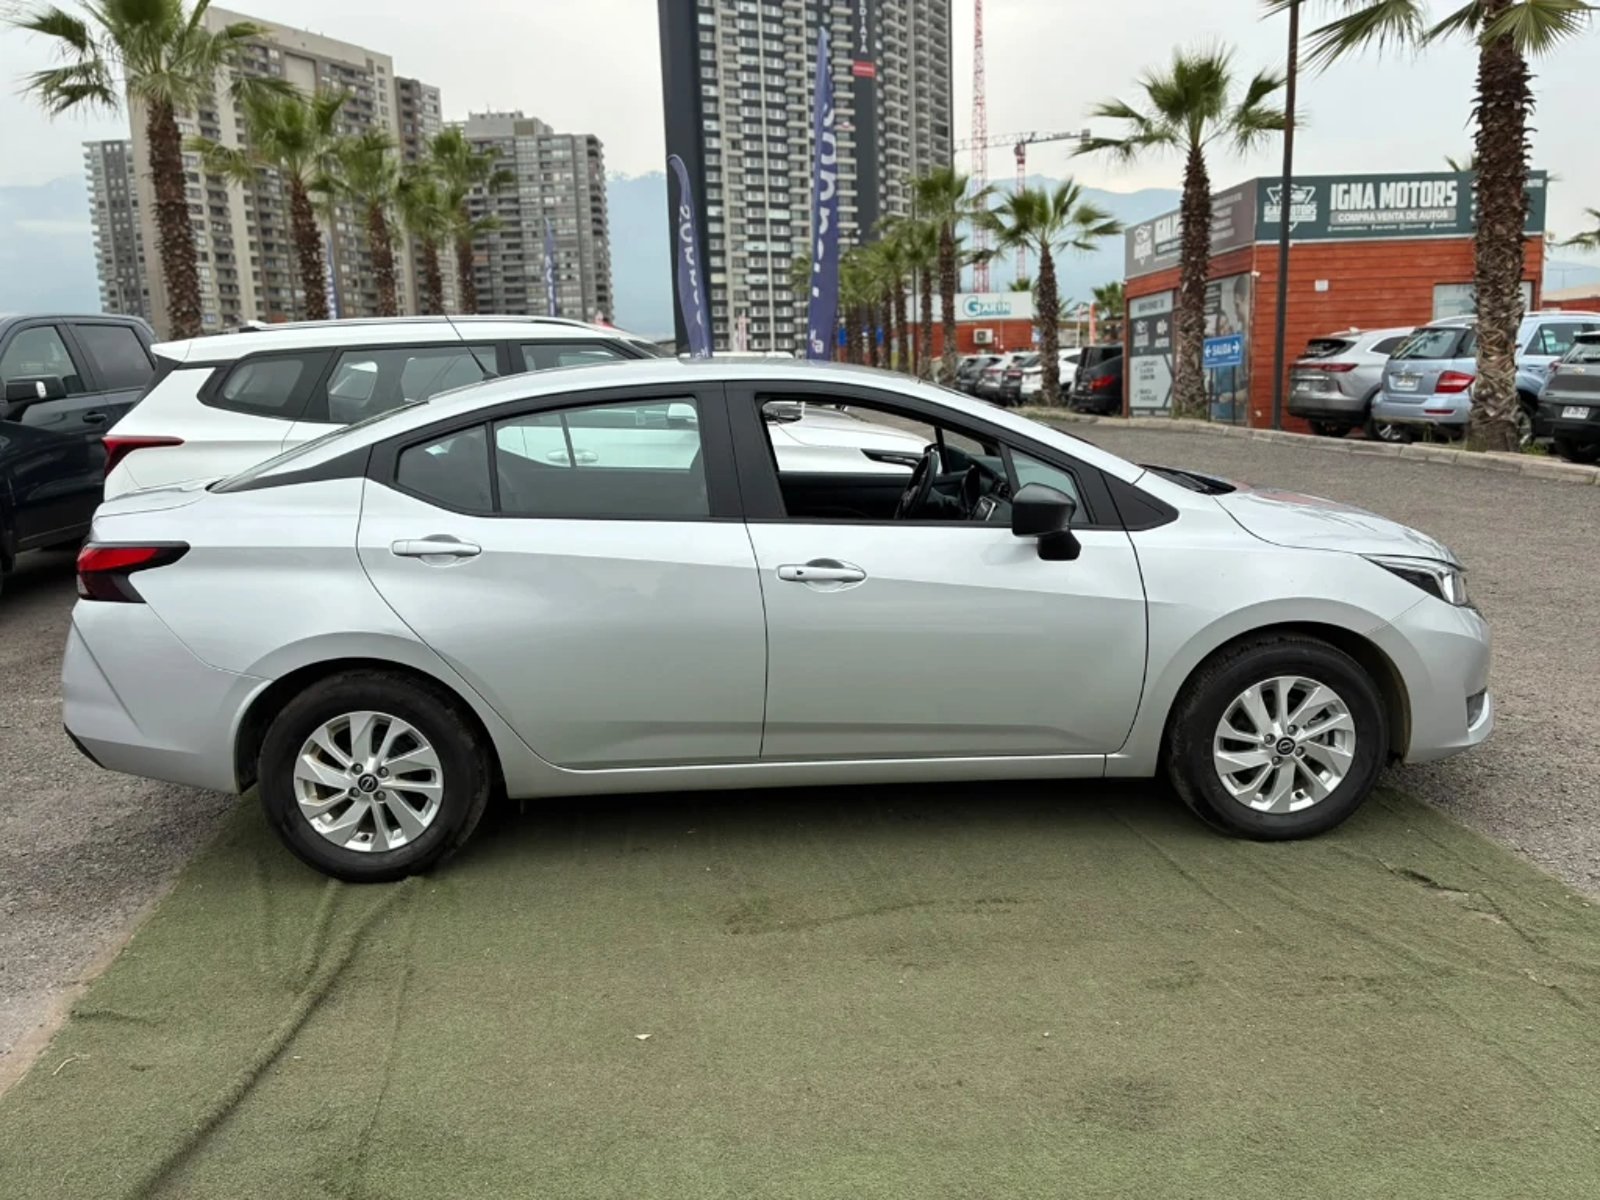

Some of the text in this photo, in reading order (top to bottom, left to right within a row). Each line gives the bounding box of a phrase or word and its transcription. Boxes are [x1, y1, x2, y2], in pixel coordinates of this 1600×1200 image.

[1330, 179, 1458, 209] IGNA MOTORS
[1337, 209, 1449, 222] COMPRA VENTA DE AUTOS
